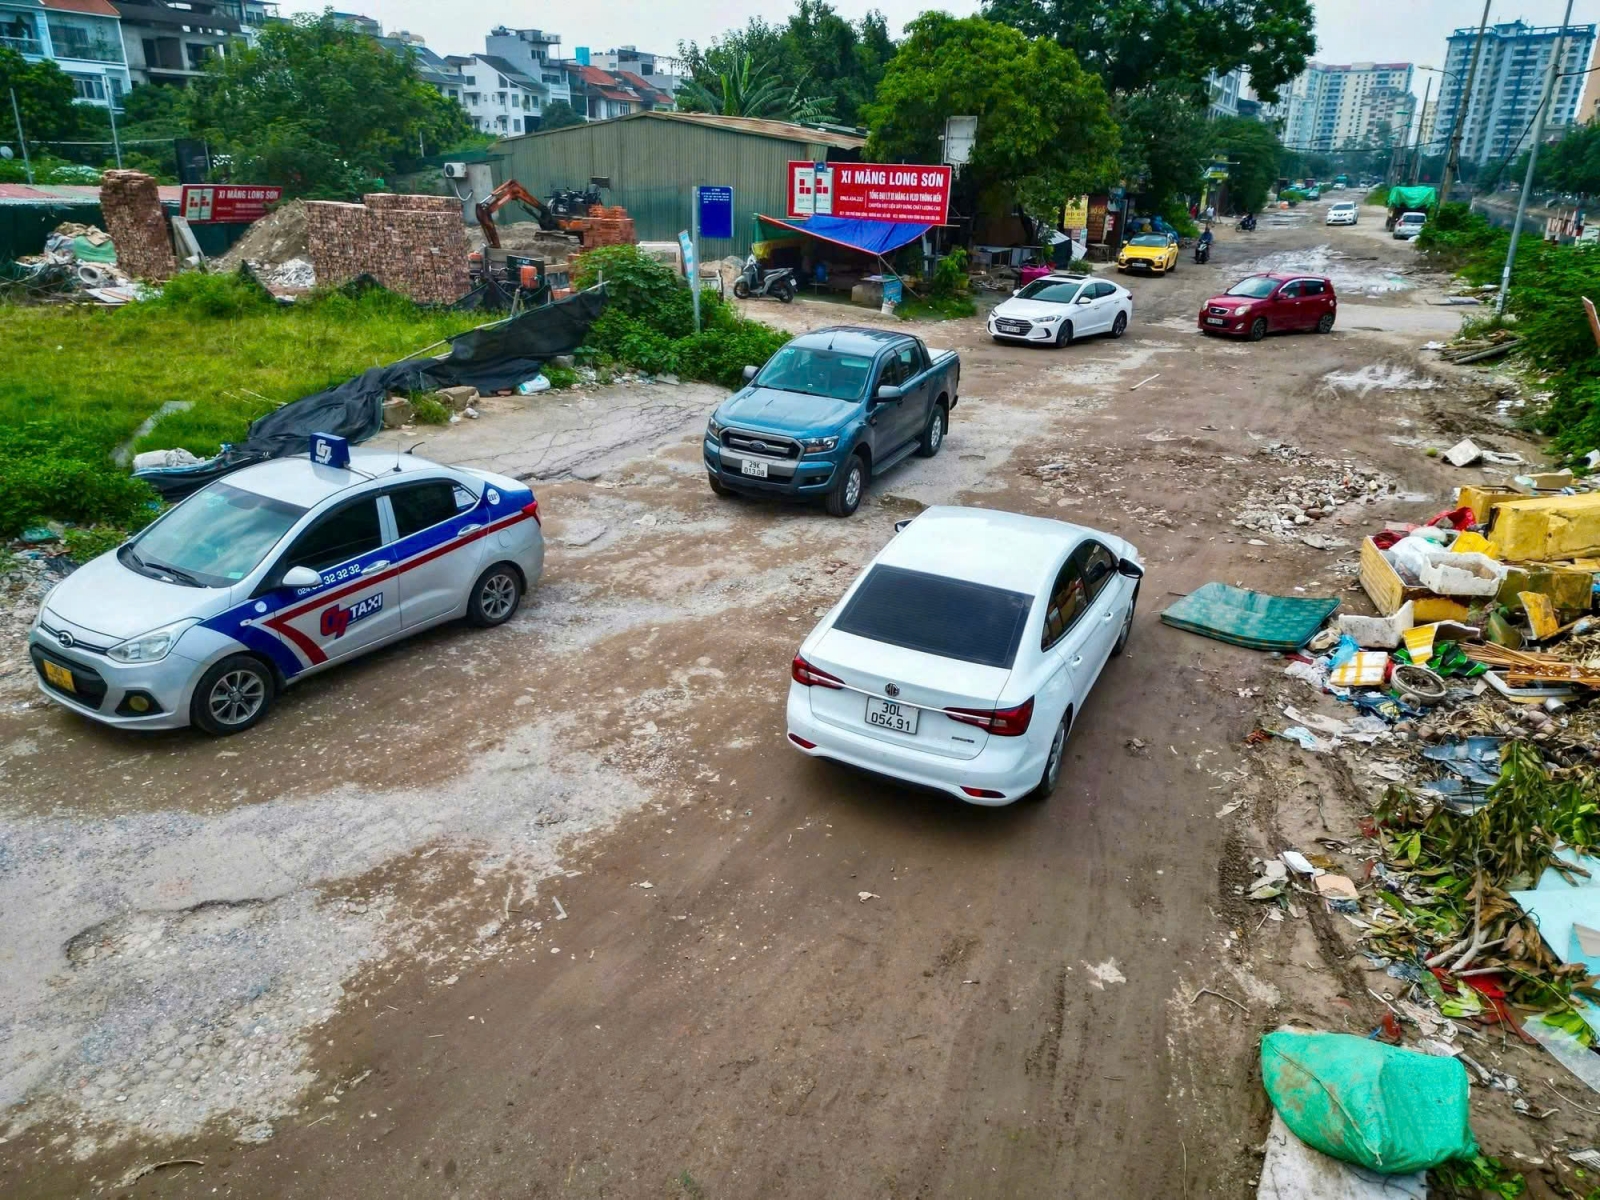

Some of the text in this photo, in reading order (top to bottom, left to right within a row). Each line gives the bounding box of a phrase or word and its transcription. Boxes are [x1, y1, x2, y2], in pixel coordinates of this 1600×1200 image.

[841, 169, 944, 188] XI MĂNG LONG SƠN
[218, 190, 226, 199] XI
[248, 190, 264, 199] LONG
[749, 460, 760, 468] 29K
[324, 574, 336, 584] 32
[336, 570, 348, 580] 32
[349, 564, 361, 575] 32
[350, 594, 382, 618] TAXI
[882, 702, 903, 717] 30L
[871, 713, 910, 731] 054.91
